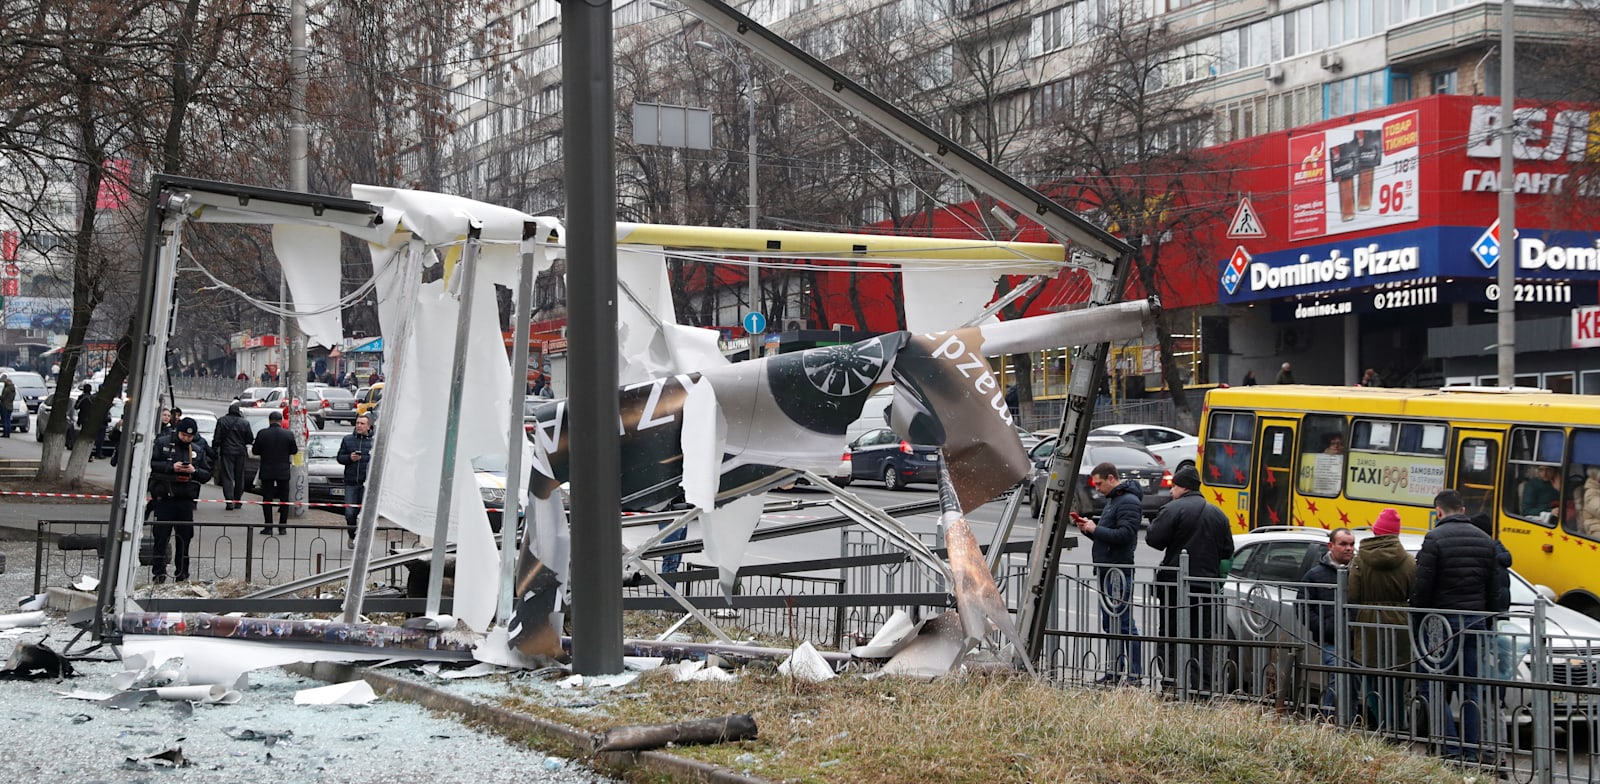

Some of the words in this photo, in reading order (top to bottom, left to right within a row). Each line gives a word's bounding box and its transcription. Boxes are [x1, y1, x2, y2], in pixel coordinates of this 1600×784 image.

[1385, 119, 1412, 137] ТОВАР
[1462, 169, 1569, 194] ГААНТ
[1379, 181, 1404, 214] 96
[1251, 249, 1350, 291] Domino's
[1353, 243, 1419, 277] Pizza
[1513, 284, 1571, 303] 221111
[1295, 301, 1352, 319] dominos.ua
[1350, 466, 1382, 485] TAXI
[1383, 466, 1408, 494] 898
